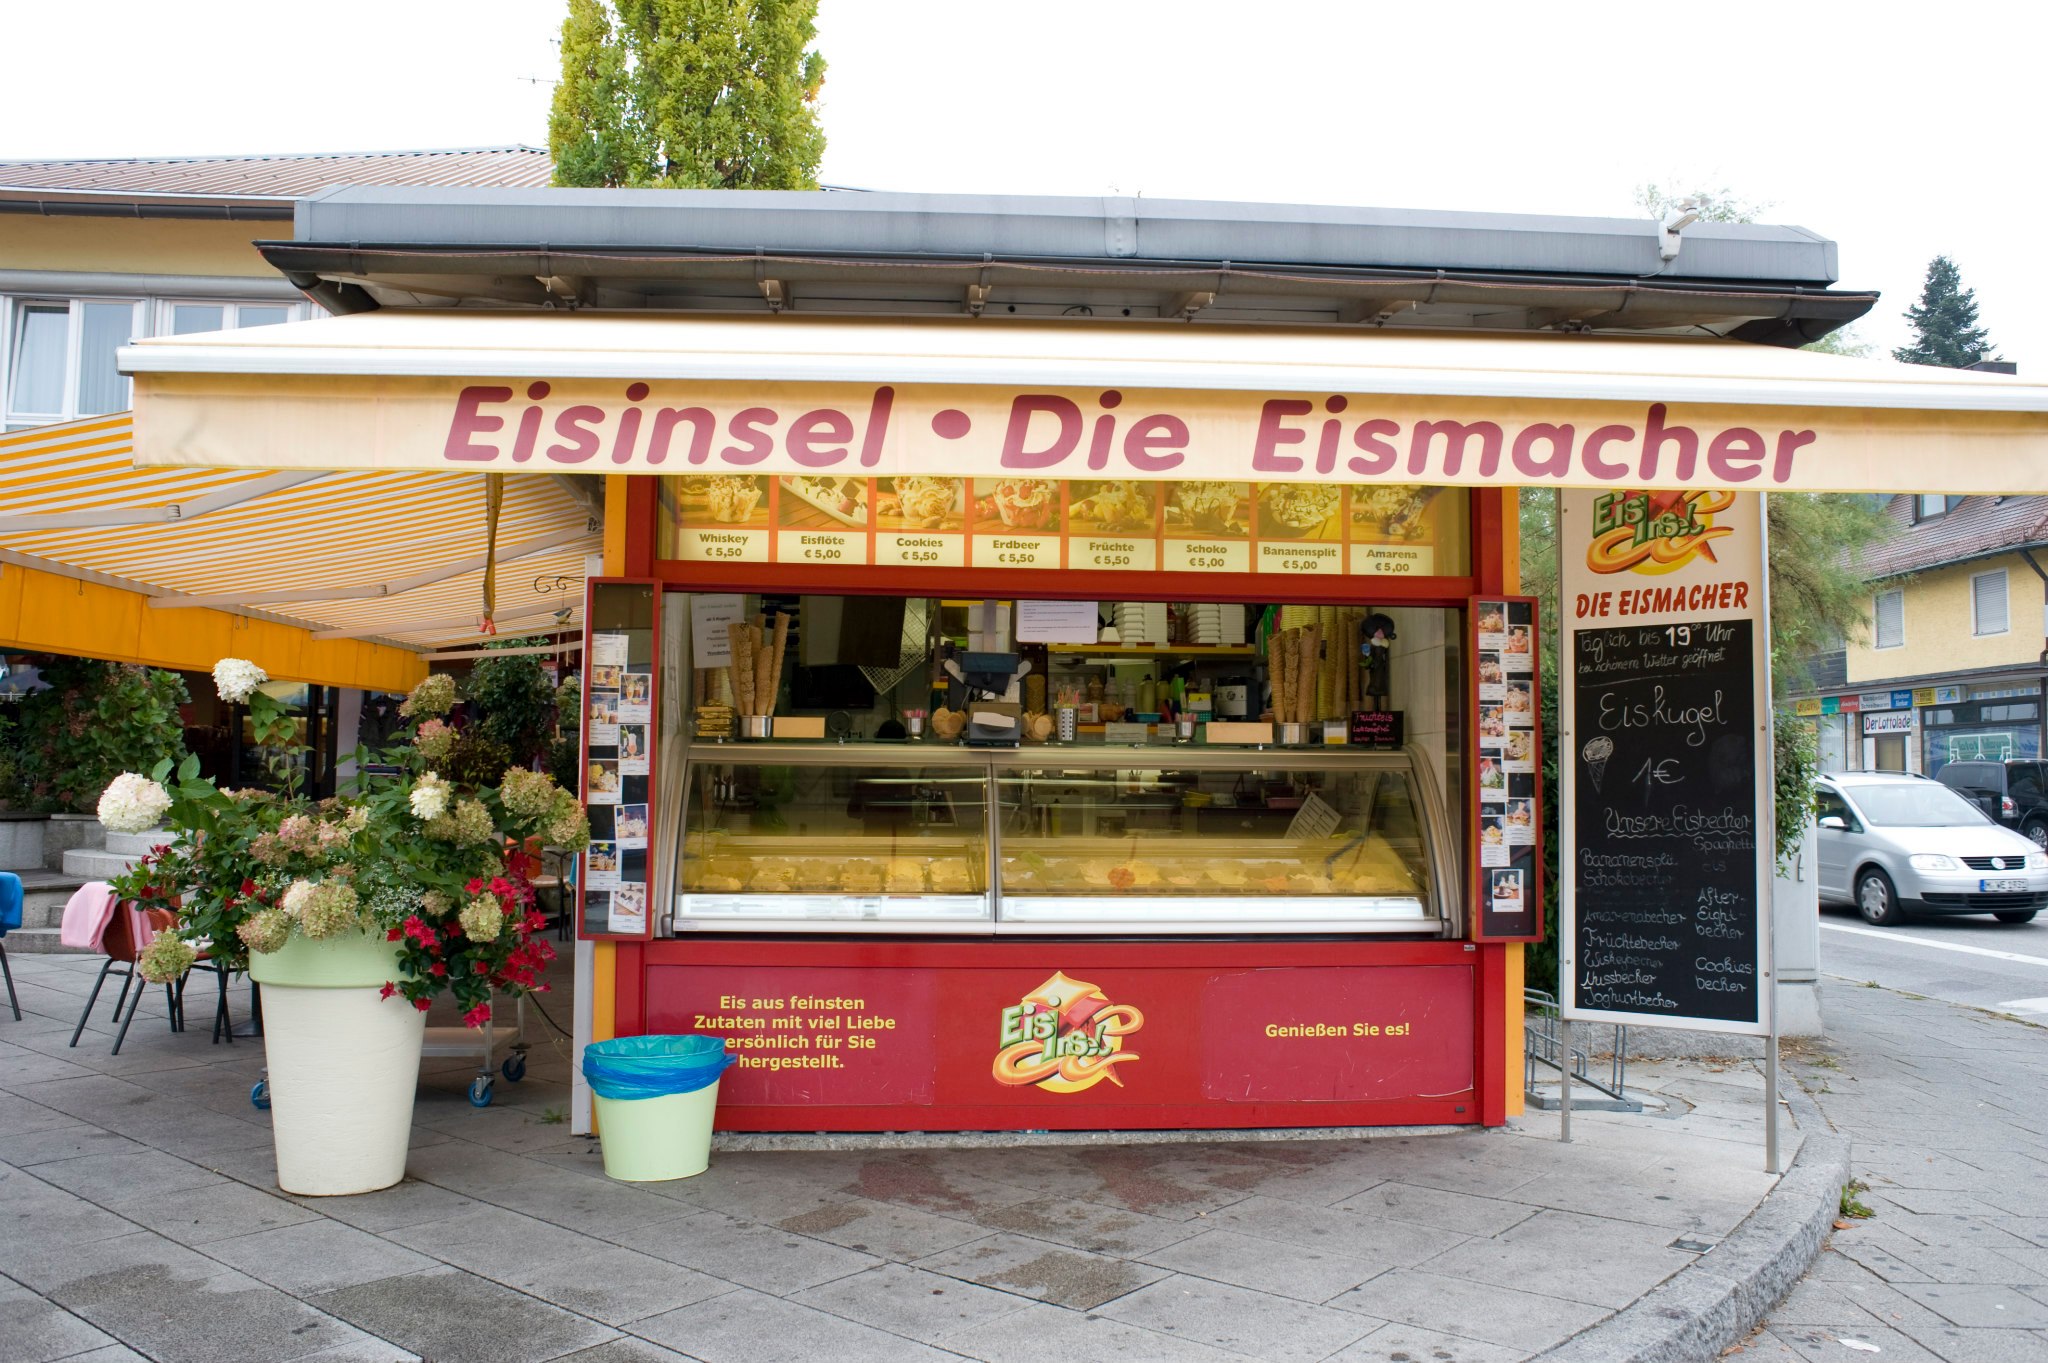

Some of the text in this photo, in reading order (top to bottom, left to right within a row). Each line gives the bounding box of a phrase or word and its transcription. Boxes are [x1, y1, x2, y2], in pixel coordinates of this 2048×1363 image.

[444, 381, 1817, 483] Eisinsel Die Eismacher
[1593, 491, 1644, 540] Eis
[1631, 494, 1705, 550] Insel
[699, 533, 748, 546] Whiskey
[800, 535, 845, 545] Eisflöte
[896, 537, 943, 548] Cookies
[992, 540, 1041, 550] Erdbeer
[1089, 542, 1134, 552] Früchte
[715, 547, 742, 558] 5,50
[815, 549, 841, 560] 5,00
[912, 551, 938, 561] 5,50
[1186, 544, 1228, 554] Schoko
[1263, 546, 1337, 558] Bananensplit
[1366, 549, 1418, 559] Amarena
[1009, 553, 1035, 564] 5,50
[1104, 555, 1130, 566] 5,50
[1198, 558, 1225, 568] 5,00
[1291, 560, 1317, 571] 5,00
[1383, 563, 1410, 573] 5,00
[1576, 581, 1749, 619] DIE EISMACHER
[1639, 630, 1661, 646] bis
[1705, 623, 1736, 643] Uhr
[1643, 653, 1677, 669] Wetter
[1682, 647, 1726, 669] geöffnet
[1599, 685, 1728, 747] Eiskugel
[1865, 714, 1911, 731] Der Lottolade
[1605, 804, 1753, 833] Unsere Eisbecher
[1695, 922, 1744, 939] becher
[1583, 927, 1681, 950] Früchtebecher
[1581, 968, 1657, 987] Nussbecher
[1696, 977, 1747, 993] becher
[720, 995, 865, 1010] Eis aus feinsten
[1584, 986, 1679, 1009] Joghurtbecher
[694, 1015, 896, 1030] Zutaten mit viel Liebe
[1000, 1004, 1056, 1050] Eis
[1040, 997, 1113, 1063] Insel
[1265, 1022, 1410, 1038] Genießen Sie es!
[724, 1034, 876, 1049] ersönlich für Sie
[739, 1054, 845, 1071] hergestellt.
